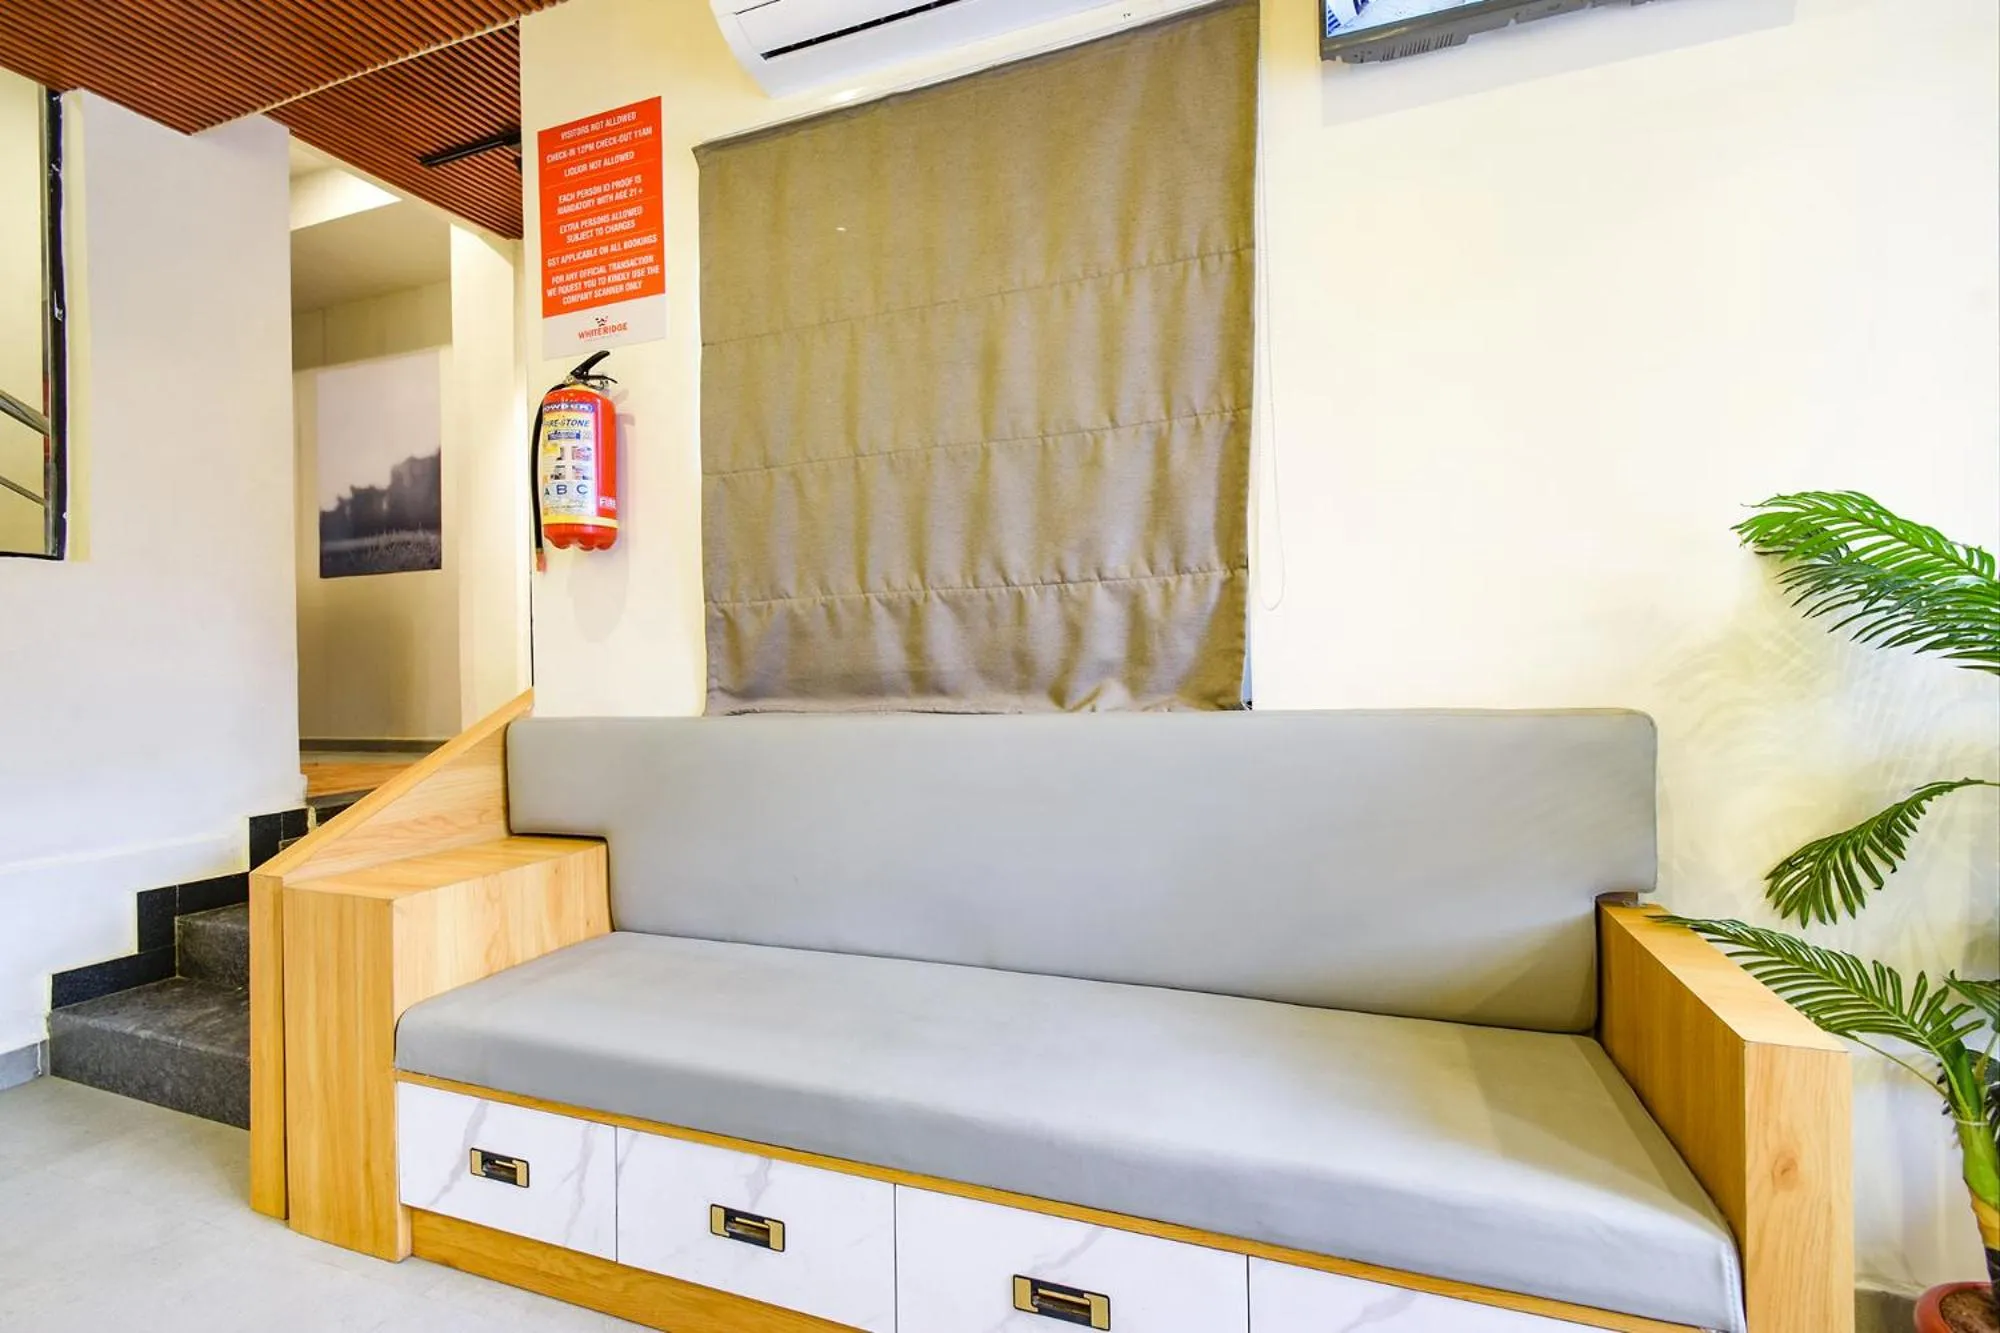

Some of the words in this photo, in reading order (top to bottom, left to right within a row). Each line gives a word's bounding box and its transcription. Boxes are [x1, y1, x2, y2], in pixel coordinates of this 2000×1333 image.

[561, 126, 589, 140] VISITORS
[591, 122, 604, 132] NOT
[605, 112, 637, 127] ALLOWED
[546, 150, 576, 163] CHECK-IN
[578, 143, 595, 154] 12PM
[596, 132, 633, 149] CHECK-OUT
[634, 126, 652, 138] 11AM
[564, 164, 588, 176] LIQUOR
[589, 160, 601, 170] NOT
[603, 151, 635, 167] ALLOWED
[558, 200, 595, 215] MANDATORY
[596, 194, 613, 205] WITH
[615, 190, 627, 202] AGE
[559, 193, 575, 204] EACH
[576, 184, 601, 198] PERSON
[603, 181, 610, 190] ID
[612, 176, 633, 189] PROOF
[634, 174, 642, 184] IS
[560, 222, 579, 234] EXTRA
[580, 214, 610, 230] PERSONS
[611, 206, 643, 221] ALLOWED
[566, 230, 593, 243] SUBJECT
[595, 226, 604, 235] TO
[605, 220, 636, 234] CHARGES
[548, 258, 559, 267] GST
[560, 248, 597, 264] APPLICABLE
[599, 246, 608, 256] ON
[610, 242, 622, 252] ALL
[623, 234, 657, 249] BOOKINGS
[546, 287, 556, 297] WE
[584, 278, 596, 288] YOU
[598, 276, 606, 286] TO
[608, 271, 630, 284] KINDLY
[632, 268, 644, 278] USE
[646, 265, 660, 274] THE
[552, 274, 564, 285] FOR
[565, 272, 578, 282] ANY
[579, 265, 607, 279] OFFICIAL
[609, 255, 654, 271] TRANSACTION
[563, 292, 592, 305] COMPANY
[594, 285, 624, 299] SCANNER
[625, 280, 642, 291] ONLY
[578, 322, 628, 339] WHITERIDGE
[556, 484, 567, 495] B
[577, 484, 588, 495] C
